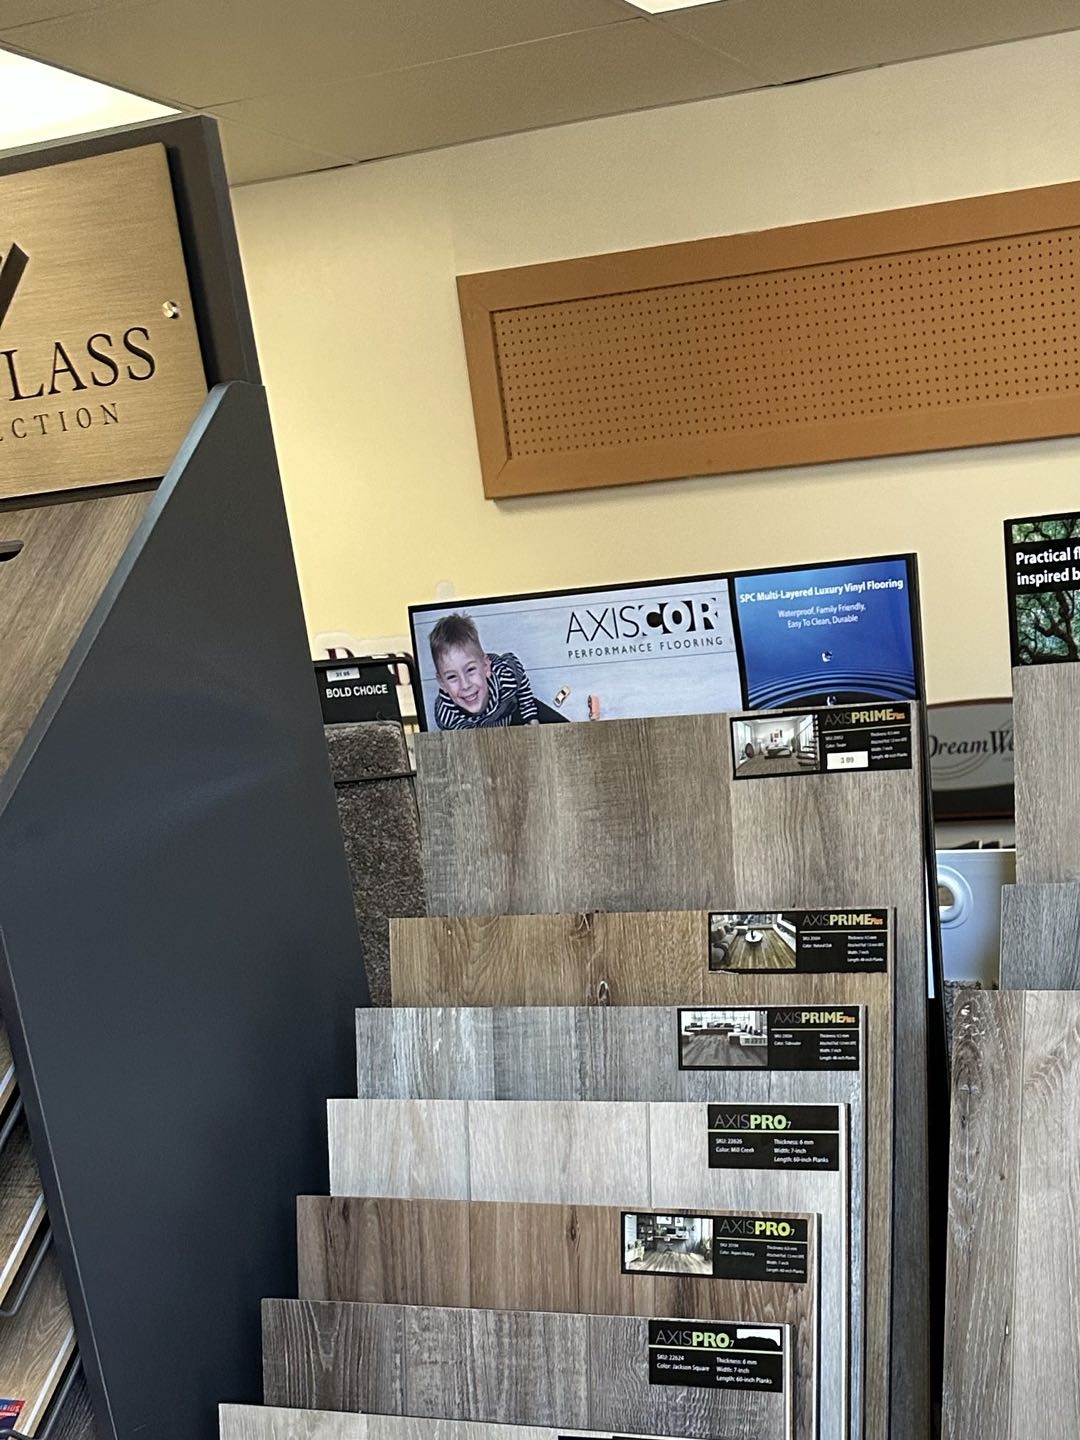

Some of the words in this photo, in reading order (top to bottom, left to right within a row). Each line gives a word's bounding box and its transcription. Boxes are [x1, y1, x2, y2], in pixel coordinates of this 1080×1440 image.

[0, 403, 120, 441] CTION
[1015, 548, 1071, 566] Practical
[1017, 568, 1070, 586] inspired
[740, 593, 755, 603] SPC
[757, 587, 813, 601] Multi-Layered
[815, 584, 843, 595] Luxury
[845, 582, 865, 591] Vinyl
[867, 580, 903, 590] Flooring
[817, 605, 837, 615] Family
[788, 620, 802, 629] Easy
[803, 618, 811, 626] To
[832, 615, 858, 624] Durable
[568, 642, 653, 659] PERFORMANCE
[660, 636, 723, 650] FLOORING
[326, 686, 351, 698] BOLD
[354, 684, 388, 696] CHOICE
